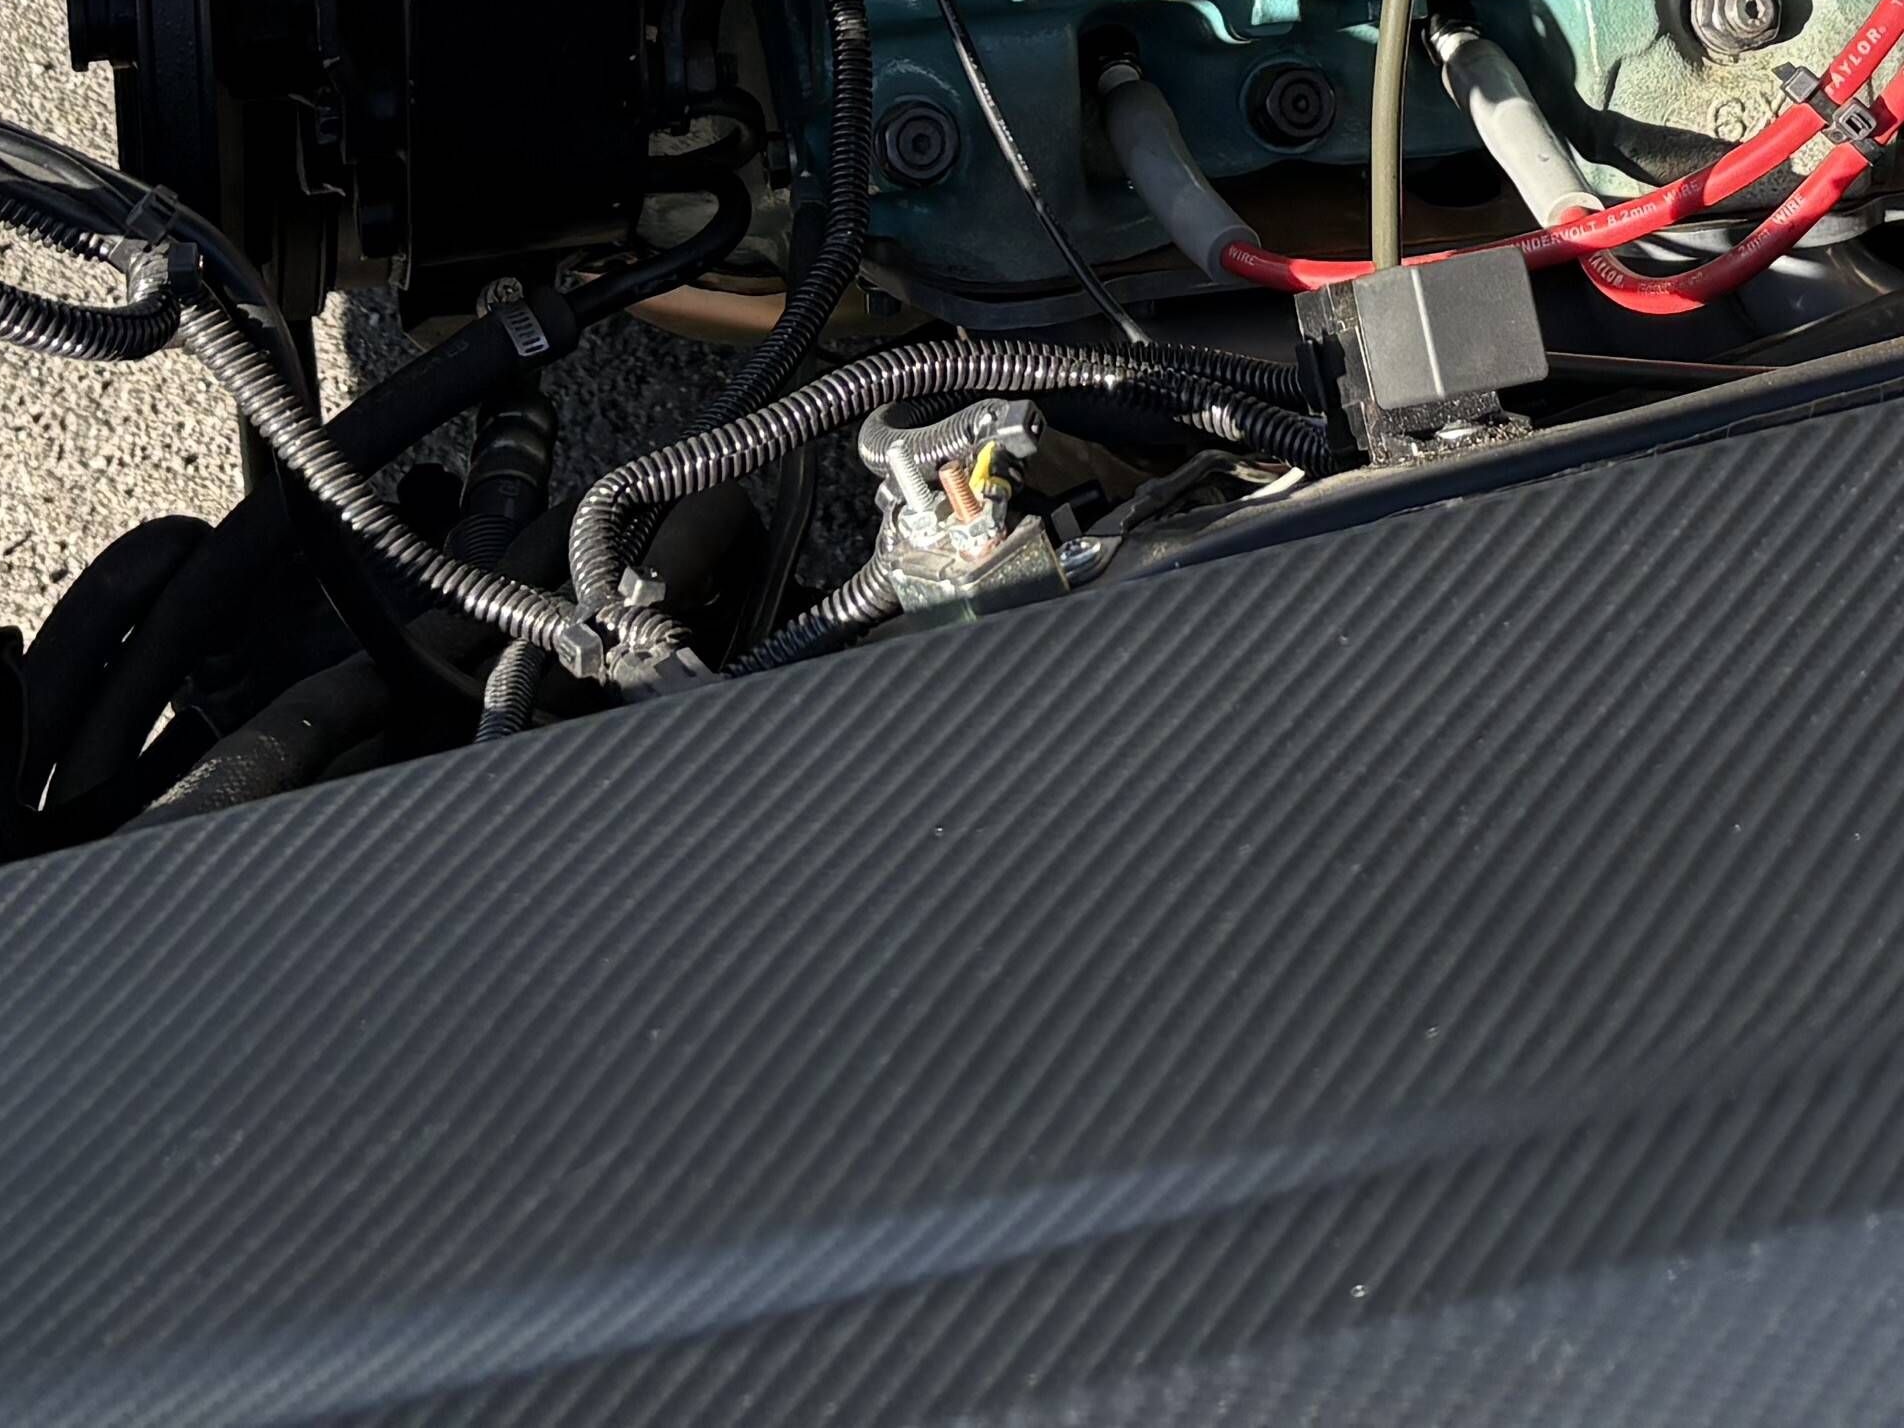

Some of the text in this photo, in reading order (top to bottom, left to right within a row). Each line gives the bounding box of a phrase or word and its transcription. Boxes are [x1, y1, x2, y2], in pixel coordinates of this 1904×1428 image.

[1772, 190, 1806, 227] WIRE
[1514, 221, 1597, 254] NDERVOLT
[1607, 201, 1657, 227] 8.2mm
[1228, 244, 1258, 267] WIRE
